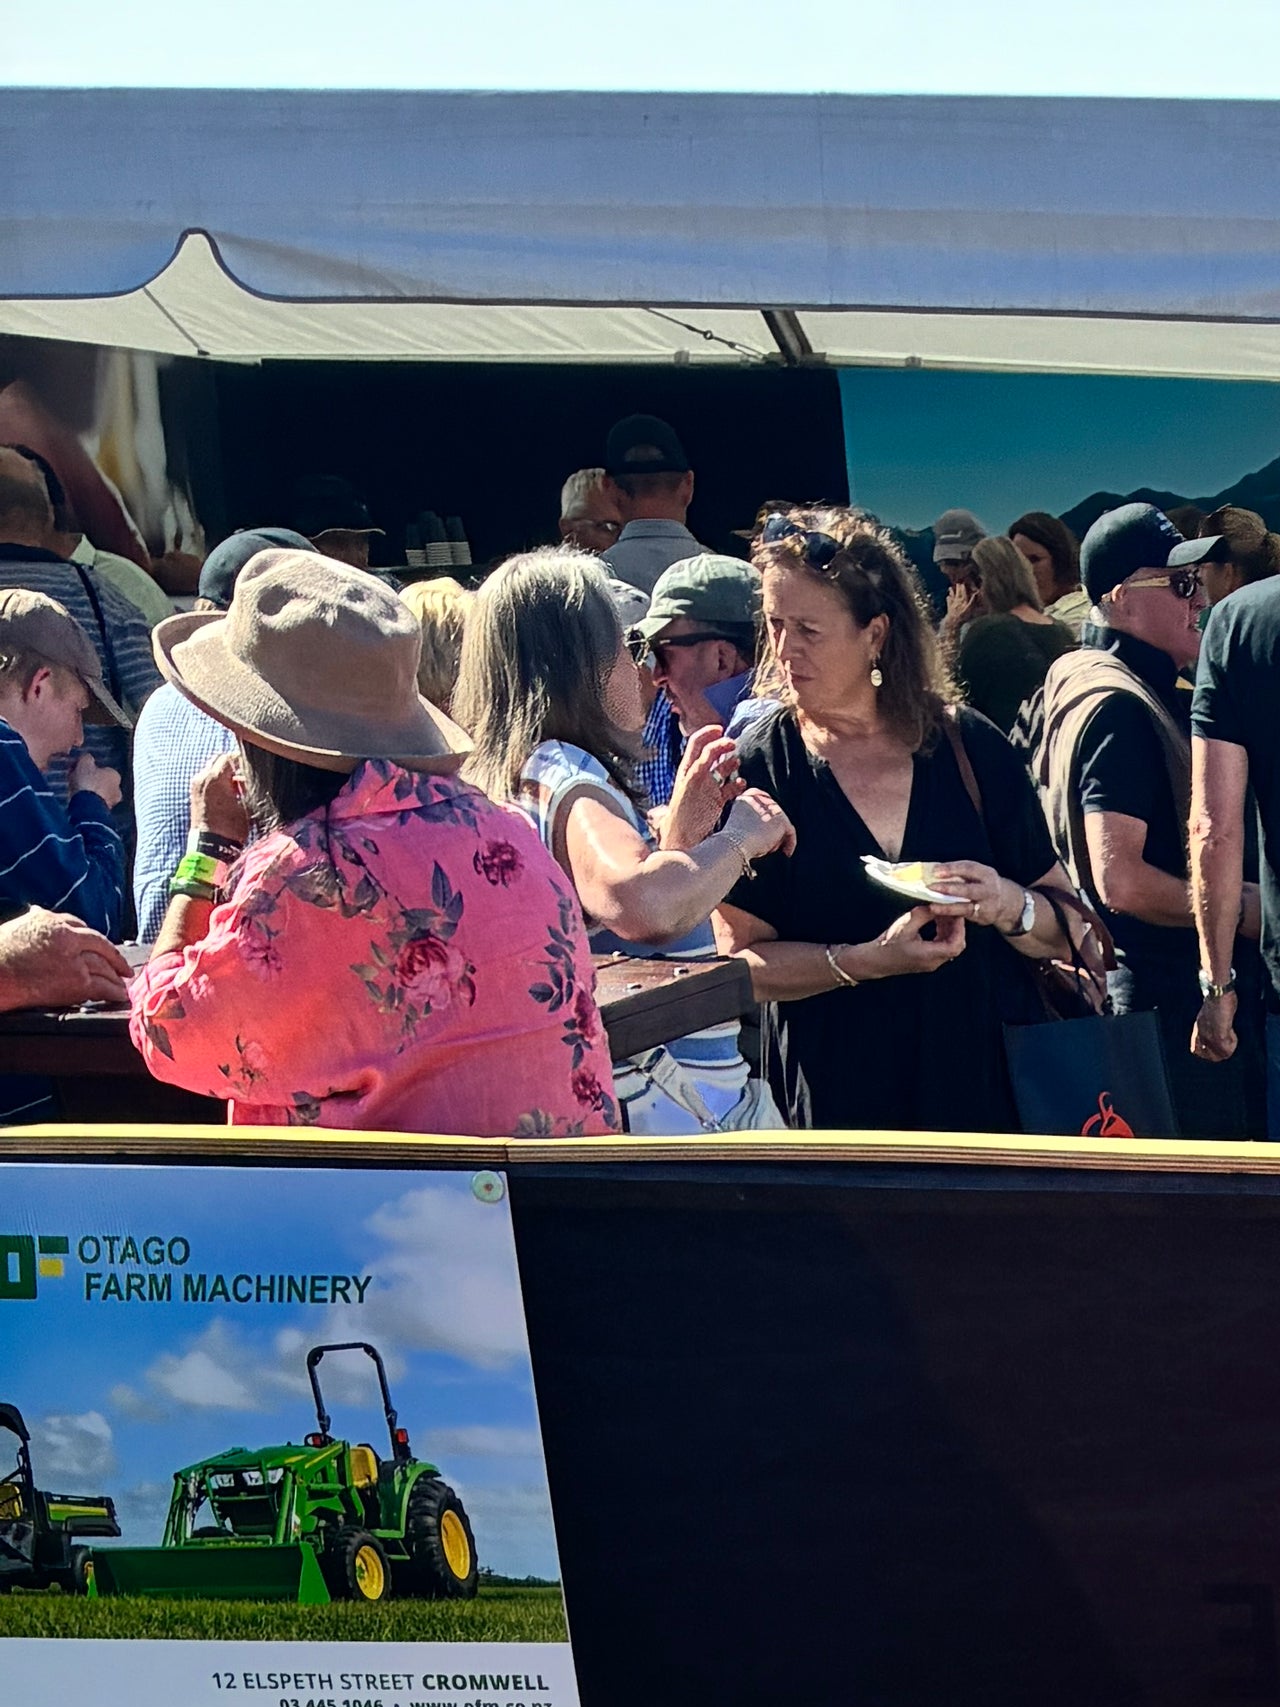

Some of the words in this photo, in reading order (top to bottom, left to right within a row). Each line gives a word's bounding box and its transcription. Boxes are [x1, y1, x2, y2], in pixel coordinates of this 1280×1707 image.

[78, 1235, 190, 1266] OTAGO
[85, 1272, 172, 1301] FARM
[184, 1273, 372, 1304] MACHINERY
[212, 1673, 237, 1690] 12
[243, 1673, 333, 1690] ELSPETH
[340, 1673, 414, 1691] STREET
[422, 1674, 549, 1691] CROMWELL
